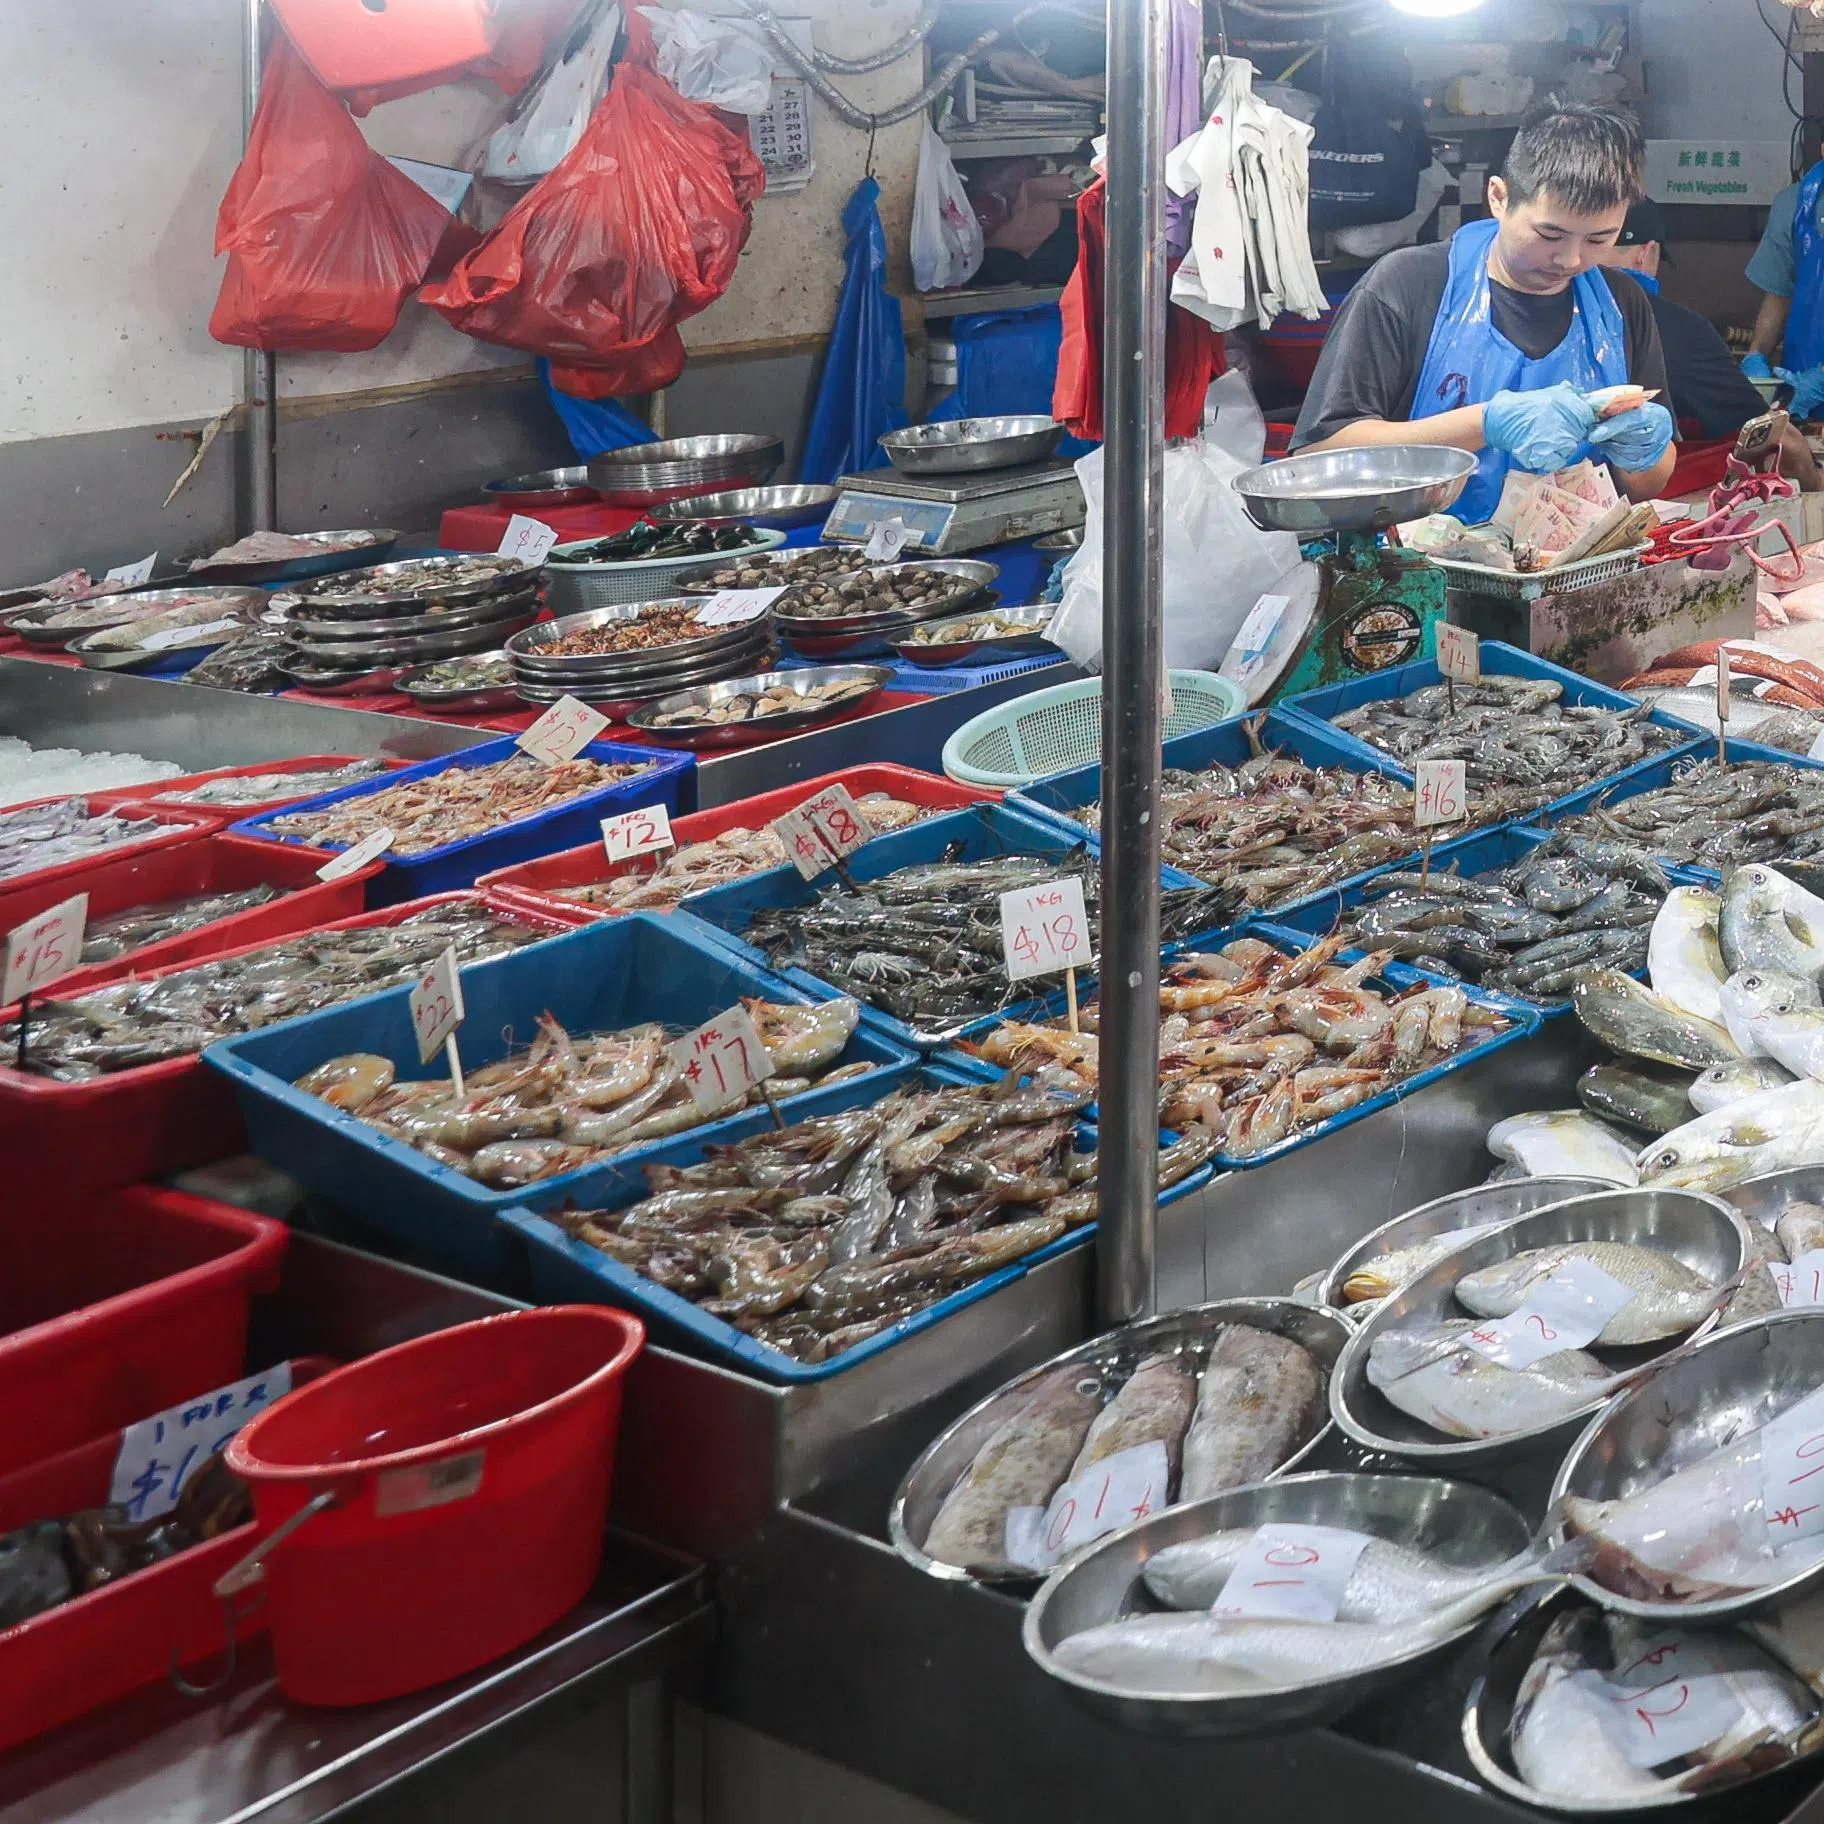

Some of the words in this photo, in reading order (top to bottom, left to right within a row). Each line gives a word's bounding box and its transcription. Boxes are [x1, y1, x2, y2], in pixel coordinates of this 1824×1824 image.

[1666, 180, 1694, 193] Fresh
[1696, 180, 1748, 196] Vegetables
[1420, 778, 1457, 817] $16
[1013, 914, 1078, 965] $18
[686, 1036, 750, 1093] $17
